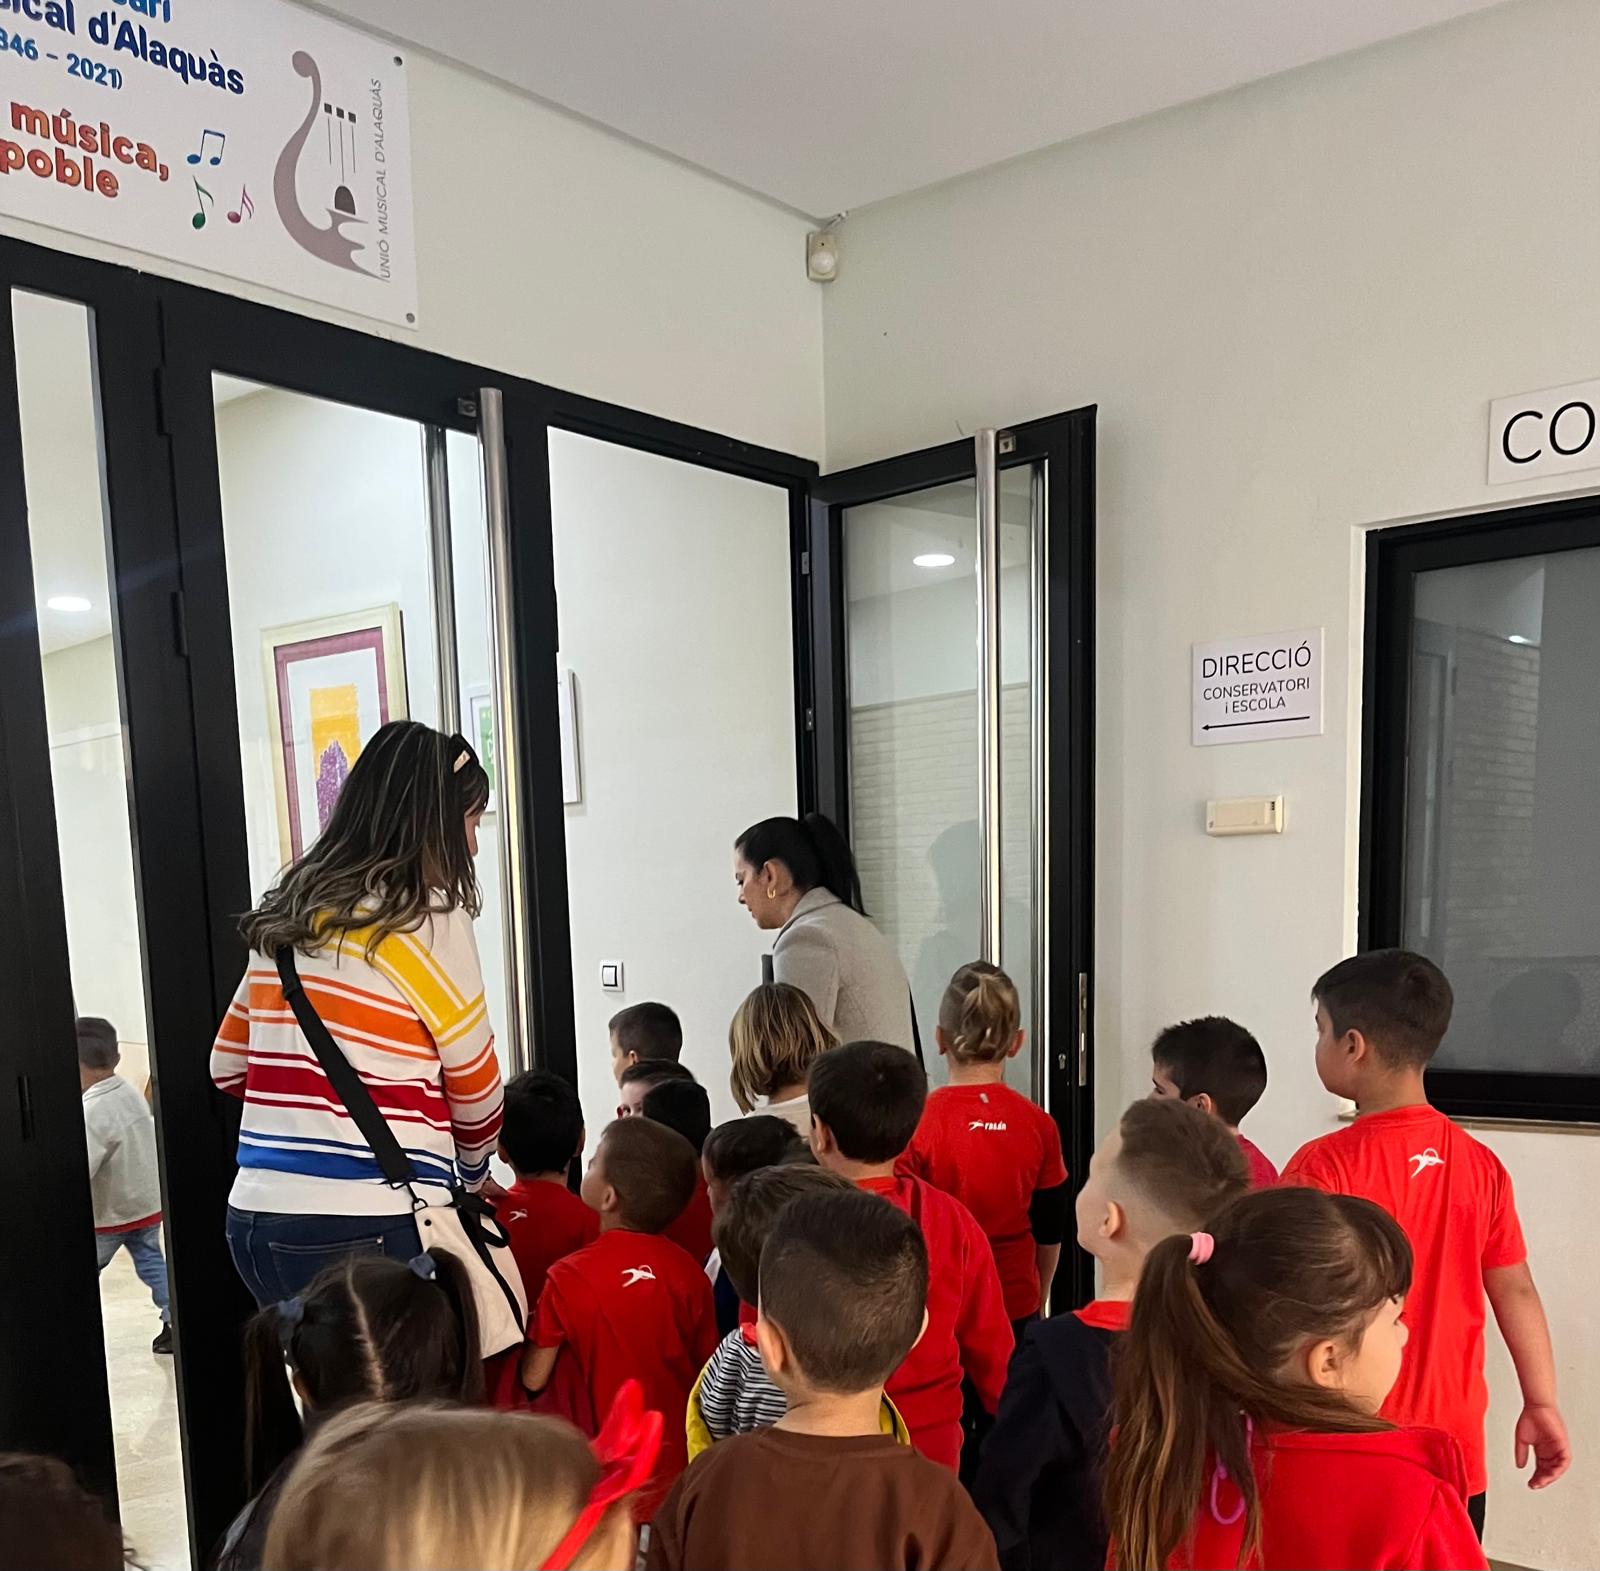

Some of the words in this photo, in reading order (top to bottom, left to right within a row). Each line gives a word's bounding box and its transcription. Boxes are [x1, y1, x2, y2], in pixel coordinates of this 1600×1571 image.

[112, 0, 170, 23] ari
[66, 53, 122, 90] 2021)
[88, 11, 244, 94] d'Alaquàs
[11, 102, 169, 181] música,
[0, 139, 119, 198] poble
[375, 168, 389, 234] MUSICAL
[377, 239, 391, 279] UNIÓ
[1502, 401, 1596, 465] CO
[1202, 640, 1312, 679] DIRECCIÓ
[1203, 677, 1310, 701] CONSERVATORI
[1232, 696, 1286, 713] ESCOLA
